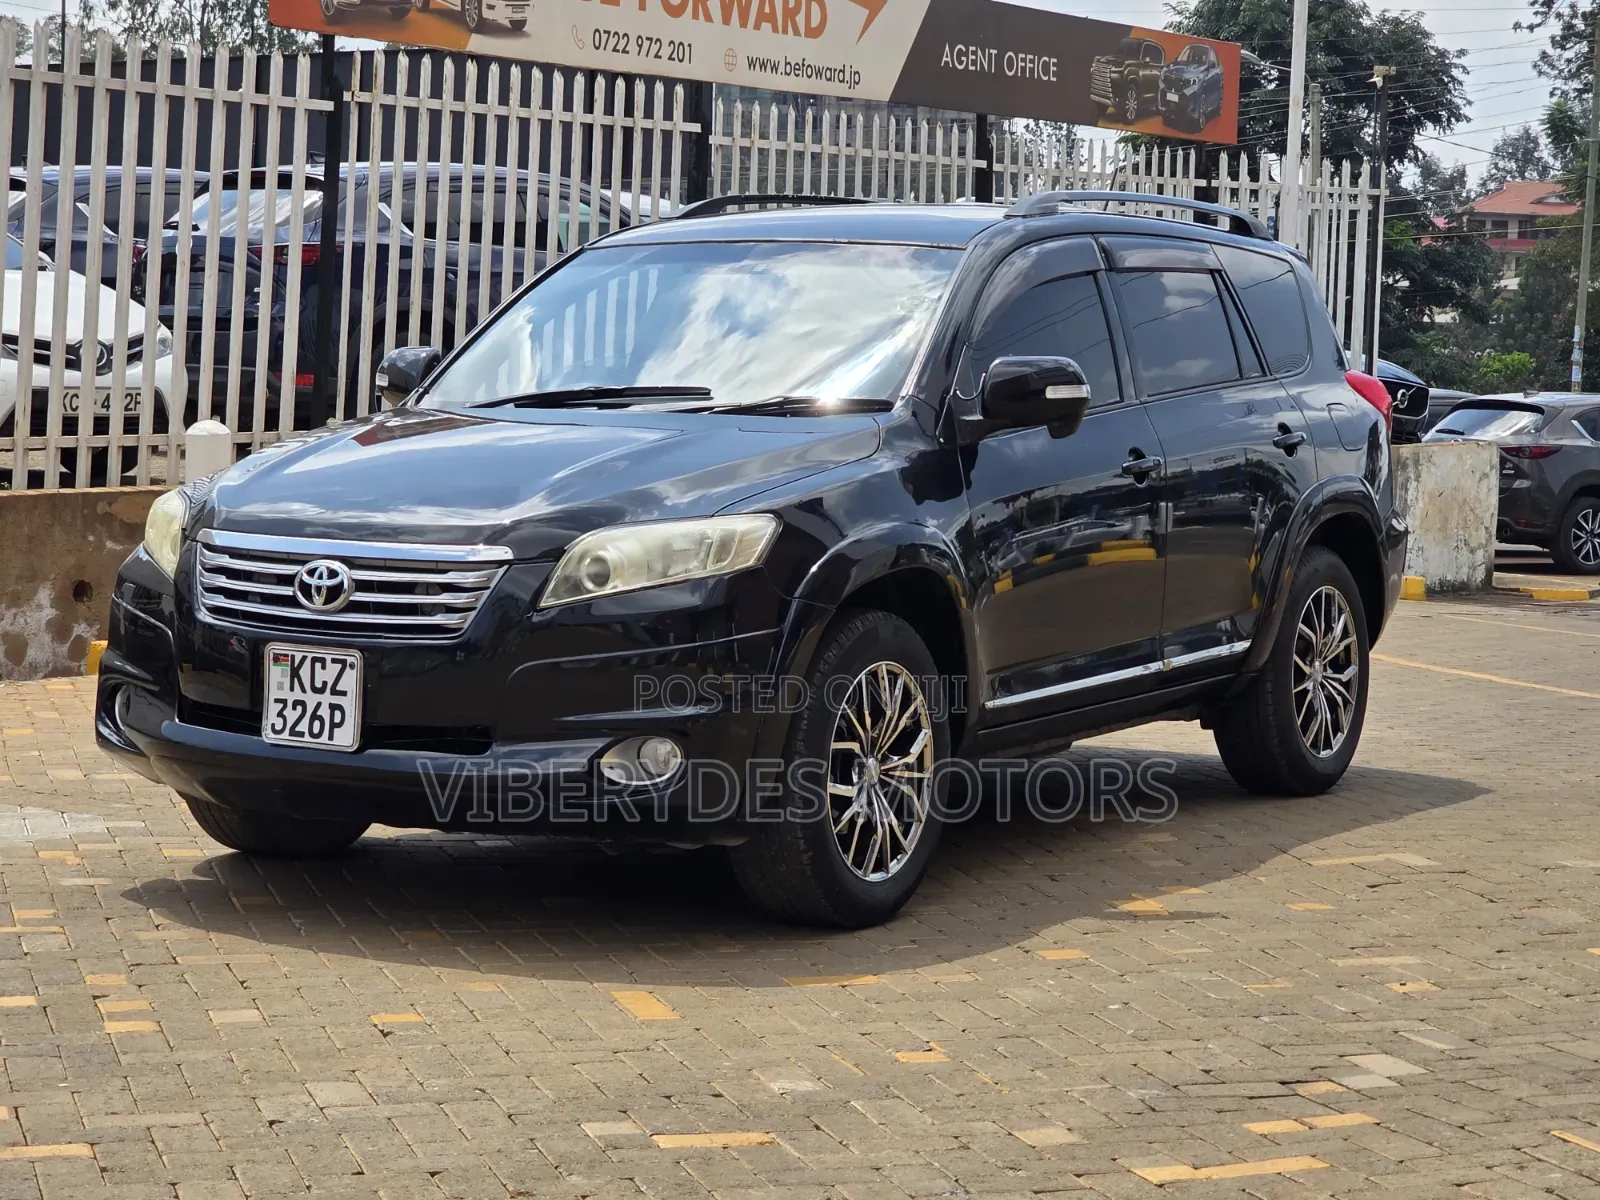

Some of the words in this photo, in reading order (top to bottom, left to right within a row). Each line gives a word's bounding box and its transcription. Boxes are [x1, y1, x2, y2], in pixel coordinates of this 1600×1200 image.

[637, 0, 828, 39] WARD
[592, 28, 630, 55] 0722
[636, 34, 662, 60] 972
[667, 40, 692, 65] 201
[941, 43, 998, 74] AGENT
[1003, 51, 1057, 82] OFFICE
[746, 55, 861, 90] www.befoward.jp
[101, 392, 142, 412] 42P
[289, 654, 348, 696] KCZ
[270, 698, 346, 742] 326P
